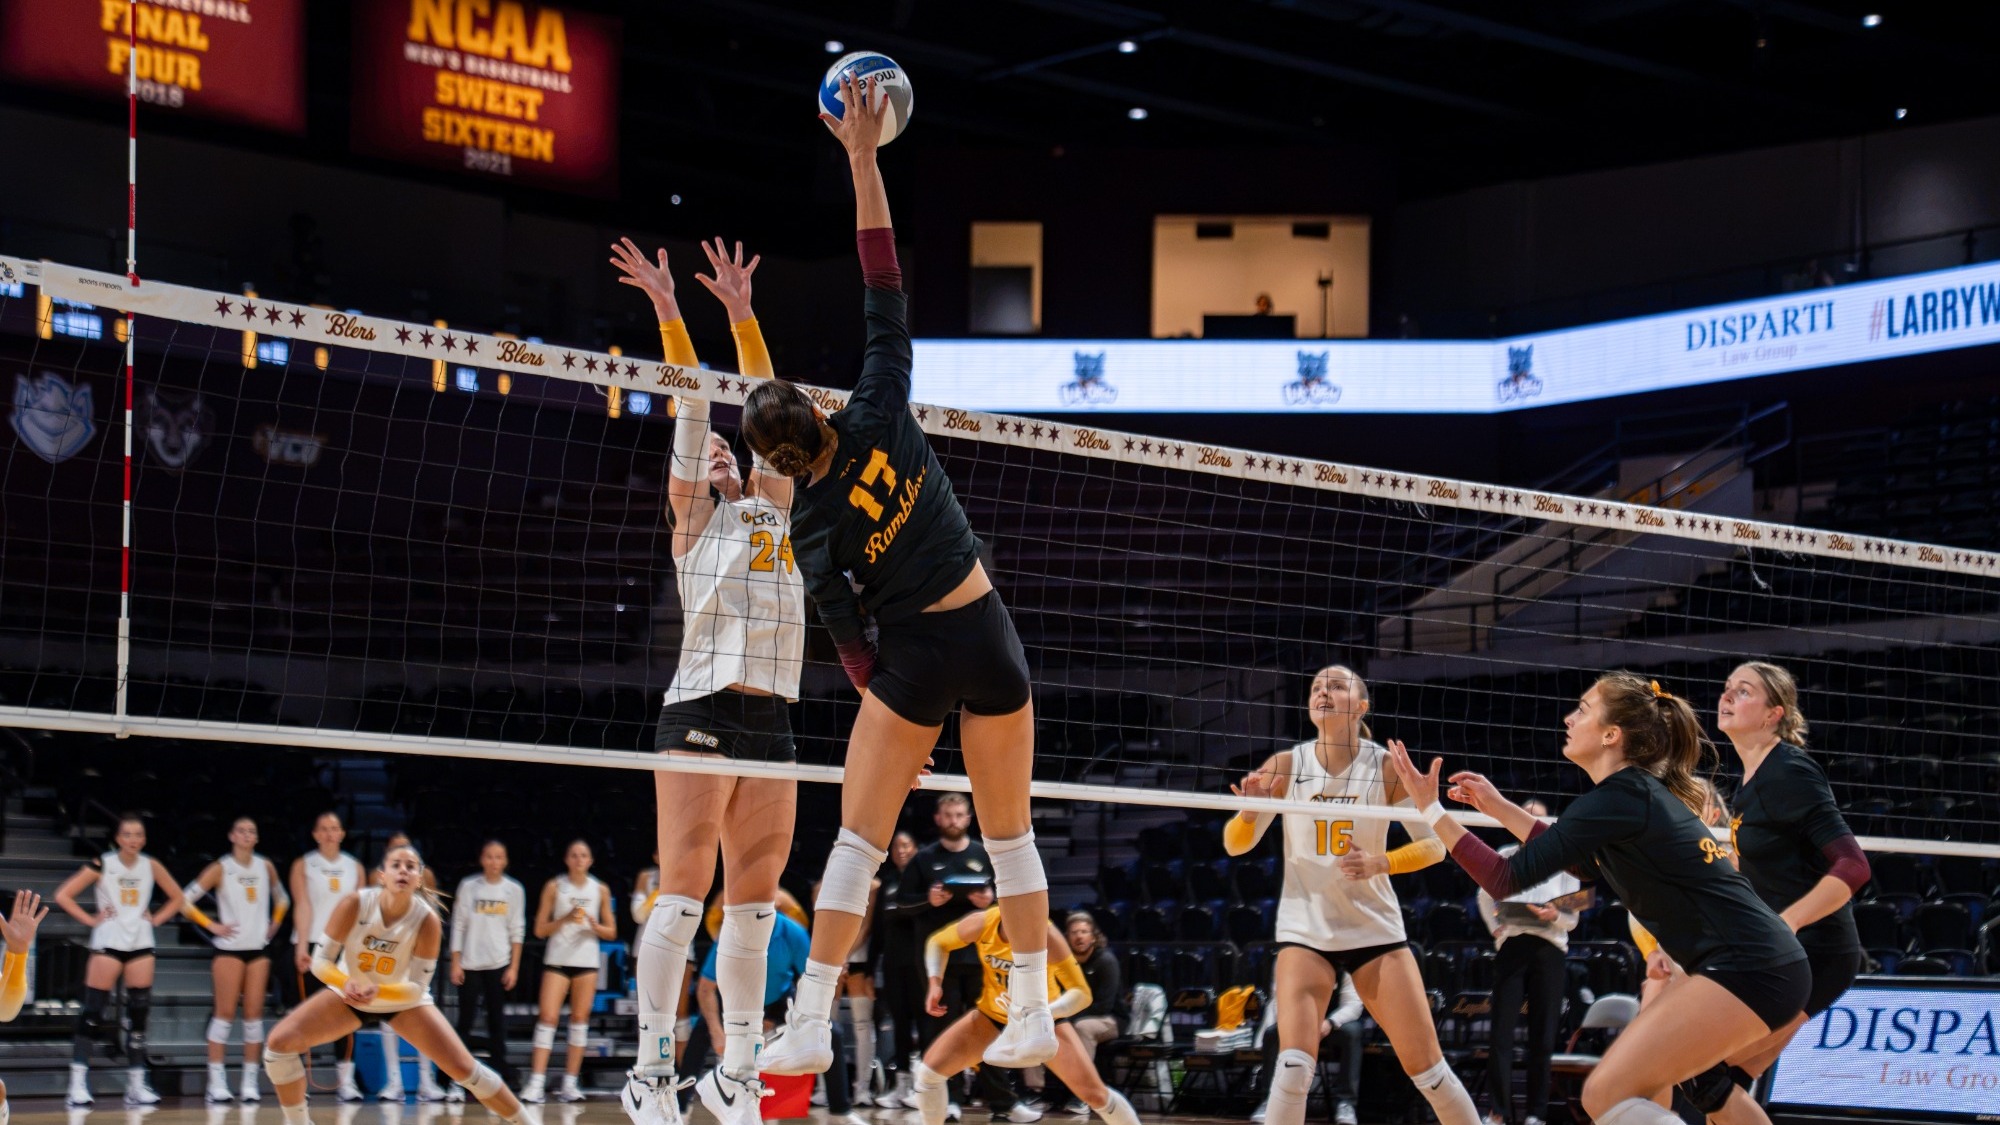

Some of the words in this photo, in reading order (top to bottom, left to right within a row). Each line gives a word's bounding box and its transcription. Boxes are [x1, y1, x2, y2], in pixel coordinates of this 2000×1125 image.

[100, 0, 210, 51] FINAL
[408, 0, 572, 73] NCAA
[107, 38, 202, 90] FOUR
[464, 54, 573, 93] BASKETBALL
[436, 70, 544, 121] SWEET
[422, 106, 555, 163] SIXTEEN
[1686, 301, 1834, 351] DISPARTI
[1721, 350, 1751, 366] Law
[1755, 343, 1799, 361] Group
[750, 530, 795, 575] 24
[1314, 819, 1354, 857] 16
[358, 952, 397, 976] 20
[1813, 1006, 2000, 1056] DISPA
[1879, 1061, 1937, 1086] Law
[1946, 1064, 2000, 1090] Gro
